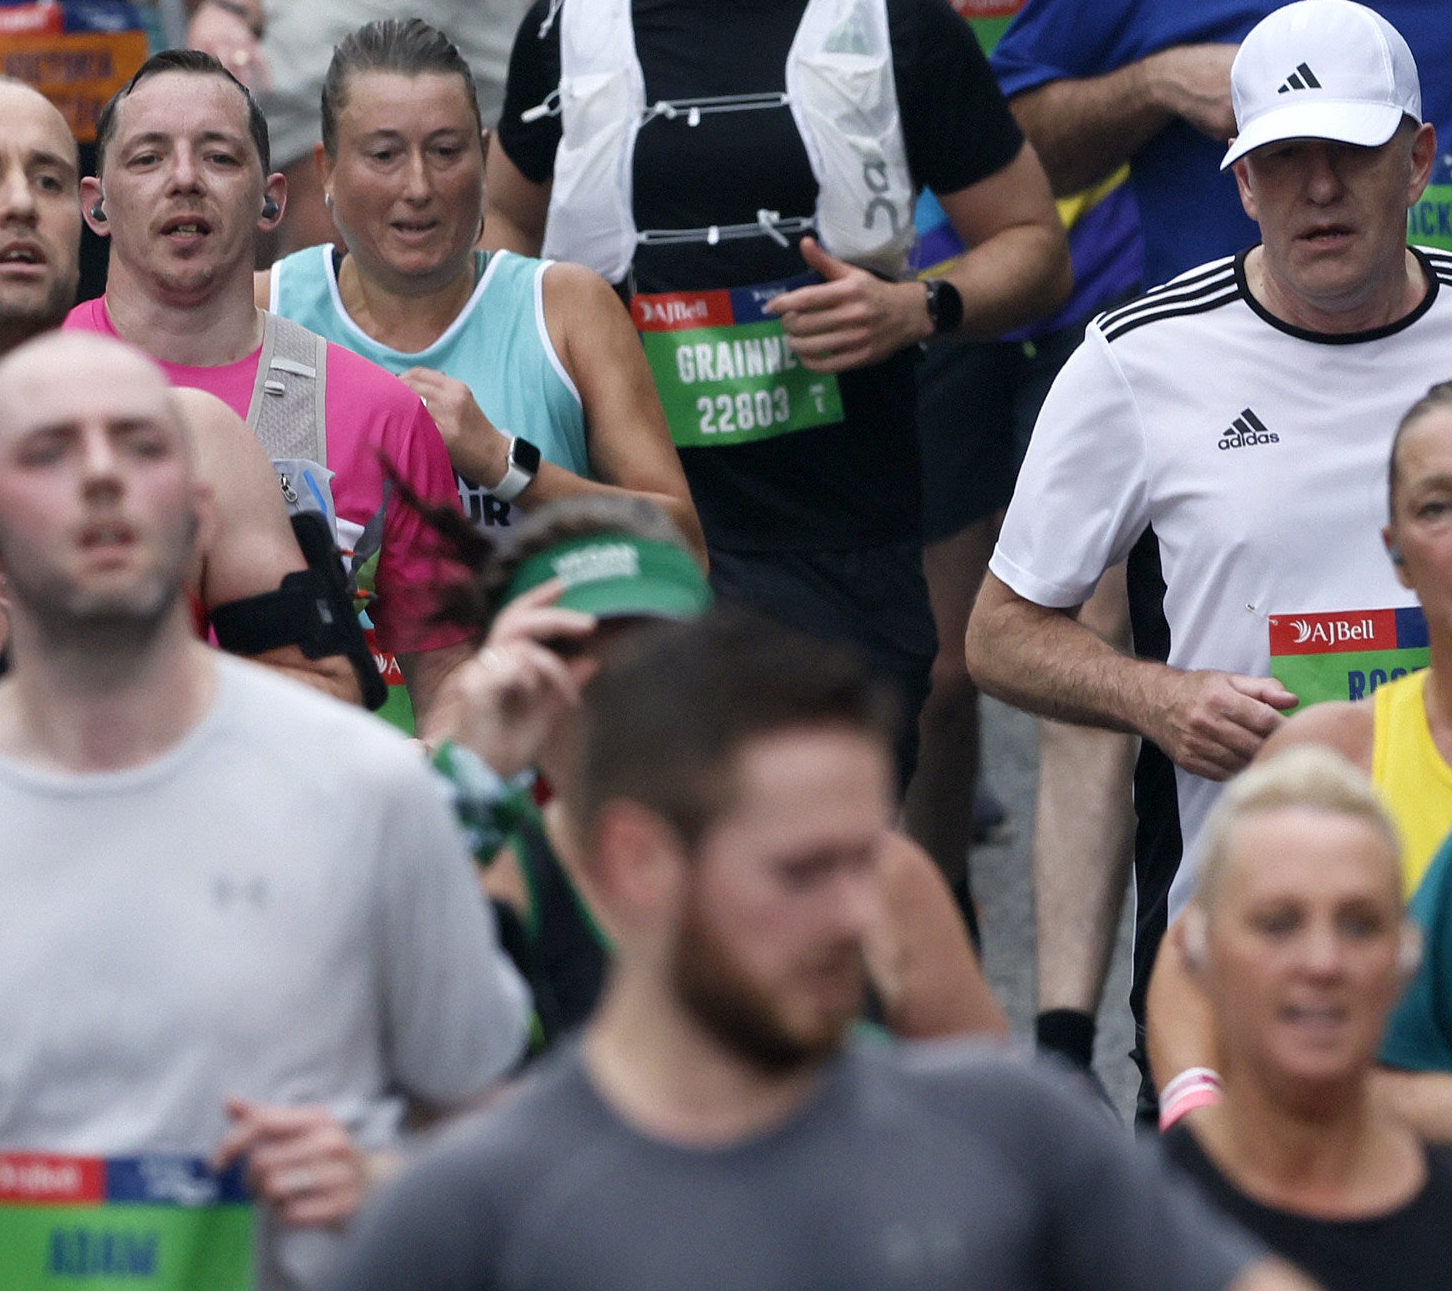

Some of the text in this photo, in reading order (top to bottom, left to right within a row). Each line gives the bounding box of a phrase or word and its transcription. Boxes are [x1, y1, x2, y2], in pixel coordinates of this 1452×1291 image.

[696, 386, 790, 434] 22803
[1218, 432, 1280, 450] adidas
[1311, 619, 1376, 646] AJBell
